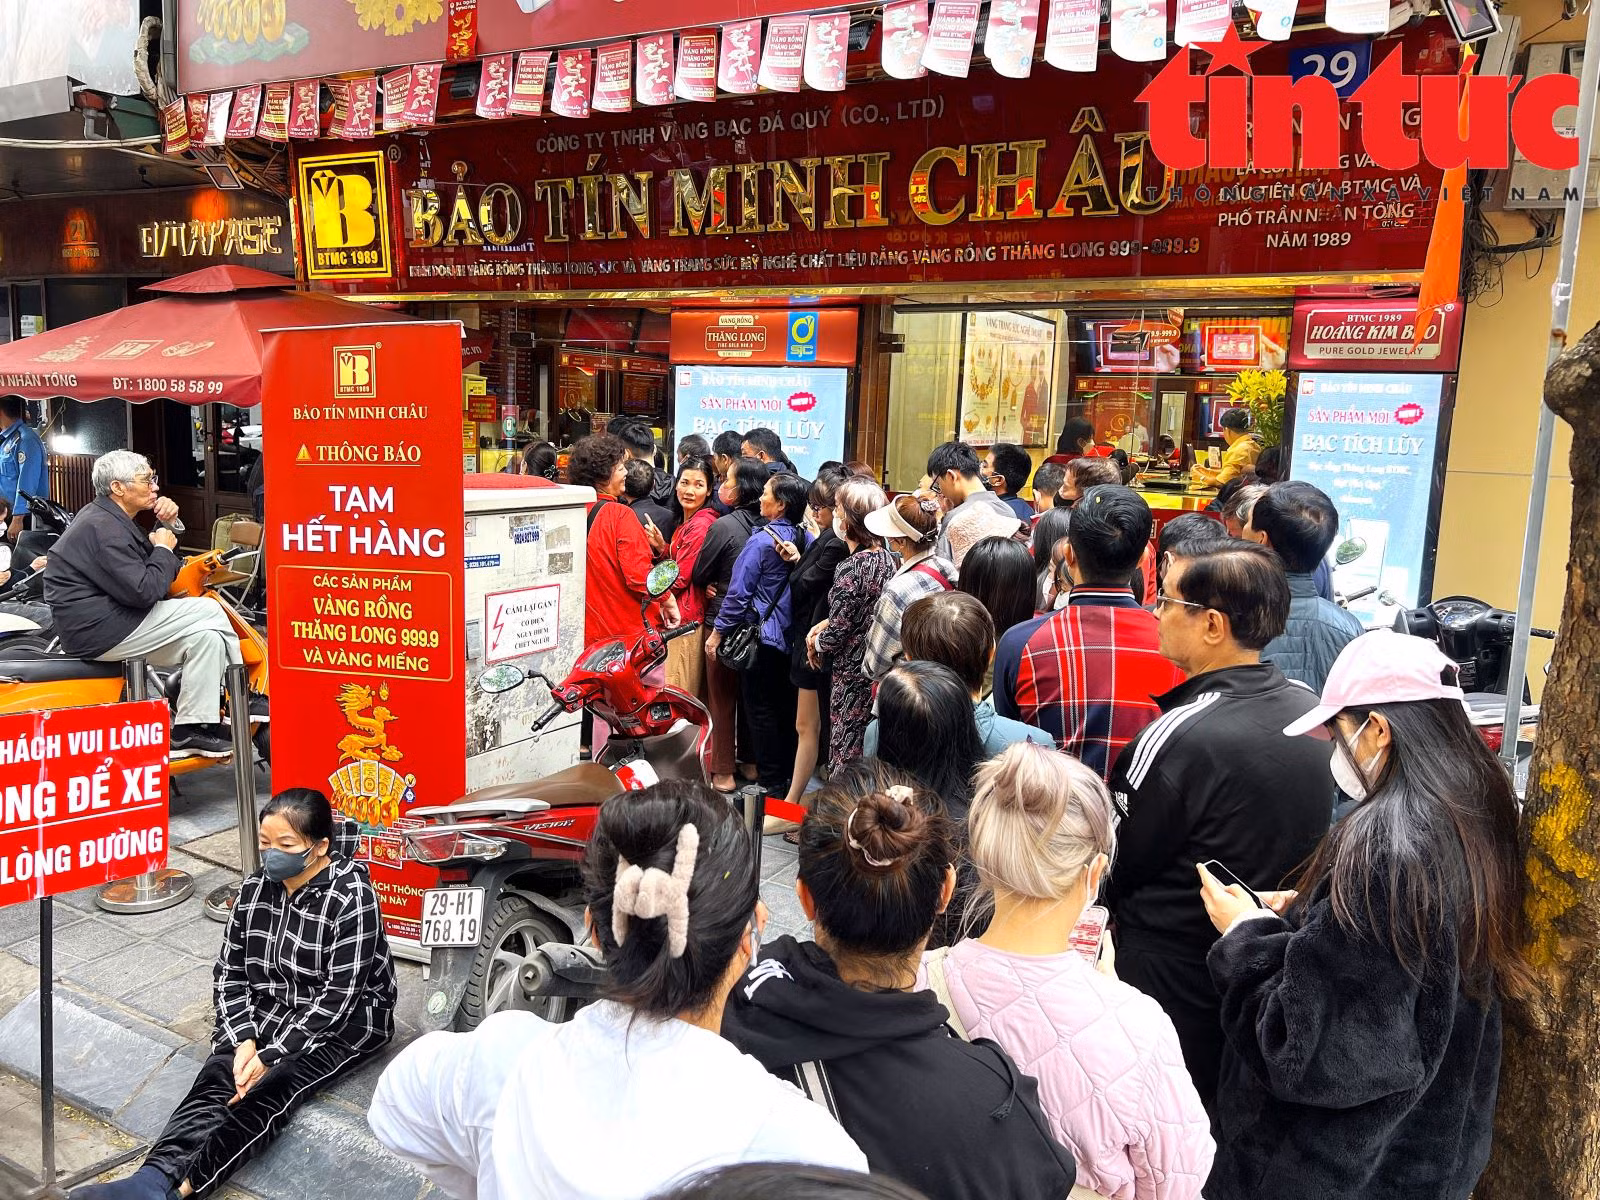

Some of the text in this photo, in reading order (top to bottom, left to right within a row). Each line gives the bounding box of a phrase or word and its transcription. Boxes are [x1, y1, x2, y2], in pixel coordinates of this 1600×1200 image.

[1301, 50, 1357, 89] 29
[536, 94, 945, 153] CÔNG TY TNHH VÀNG BẠC ĐÁ QUÝ (CO., LTD)
[406, 106, 1176, 248] BẢO TÍN MINH CHÂU
[1342, 177, 1394, 195] BTMC
[1400, 174, 1422, 193] VÀ
[1218, 206, 1252, 227] PHỐ
[1255, 204, 1302, 225] TRẦN
[1362, 201, 1415, 220] TÔNG
[1266, 230, 1352, 248] NĂM 1989
[317, 248, 379, 266] BTMC 1989
[467, 260, 494, 276] VÀNG
[622, 258, 637, 274] VÀ
[640, 255, 672, 273] VÀNG
[674, 256, 712, 272] TRANG
[714, 254, 738, 271] SỨC
[762, 252, 798, 273] NGHỆ
[800, 248, 834, 268] CHẤT
[870, 245, 908, 266] BẰNG
[912, 244, 951, 264] VÀNG
[954, 242, 996, 263] RỒNG
[1001, 240, 1056, 260] THĂNG
[1060, 241, 1105, 259] LONG
[1347, 314, 1402, 323] BTMC 1989
[706, 331, 764, 342] THĂNG LONG
[1366, 326, 1398, 340] KIM
[1400, 325, 1437, 340] BO
[1319, 346, 1344, 355] PURE
[1347, 346, 1374, 355] GOLD
[7, 372, 42, 388] NHÂN
[112, 377, 224, 394] ĐT: 1800 58 58 99
[293, 403, 428, 420] BẢO TÍN MINH CHÂU
[786, 418, 824, 440] LŨY
[316, 441, 422, 462] THÔNG BÁO
[1302, 431, 1424, 457] BẠC TÍCH LŨY
[328, 485, 394, 520] TẠM
[282, 514, 446, 558] HẾT HÀNG
[313, 573, 412, 592] CÁC SẢN PHẨM
[313, 594, 413, 620] VÀNG RỒNG
[290, 619, 440, 648] THĂNG LONG 999.9
[303, 646, 430, 672] VÀ VÀNG MIẾNG
[0, 720, 164, 765] HÁCH VUI LÒNG
[0, 757, 162, 824] NG ĐỂ XE
[0, 826, 164, 885] LÒNG ĐƯỜNG
[372, 880, 424, 897] ÁCH THÔNG
[390, 895, 408, 906] NÀY
[430, 891, 474, 917] 29-H1
[424, 918, 478, 943] 768.19
